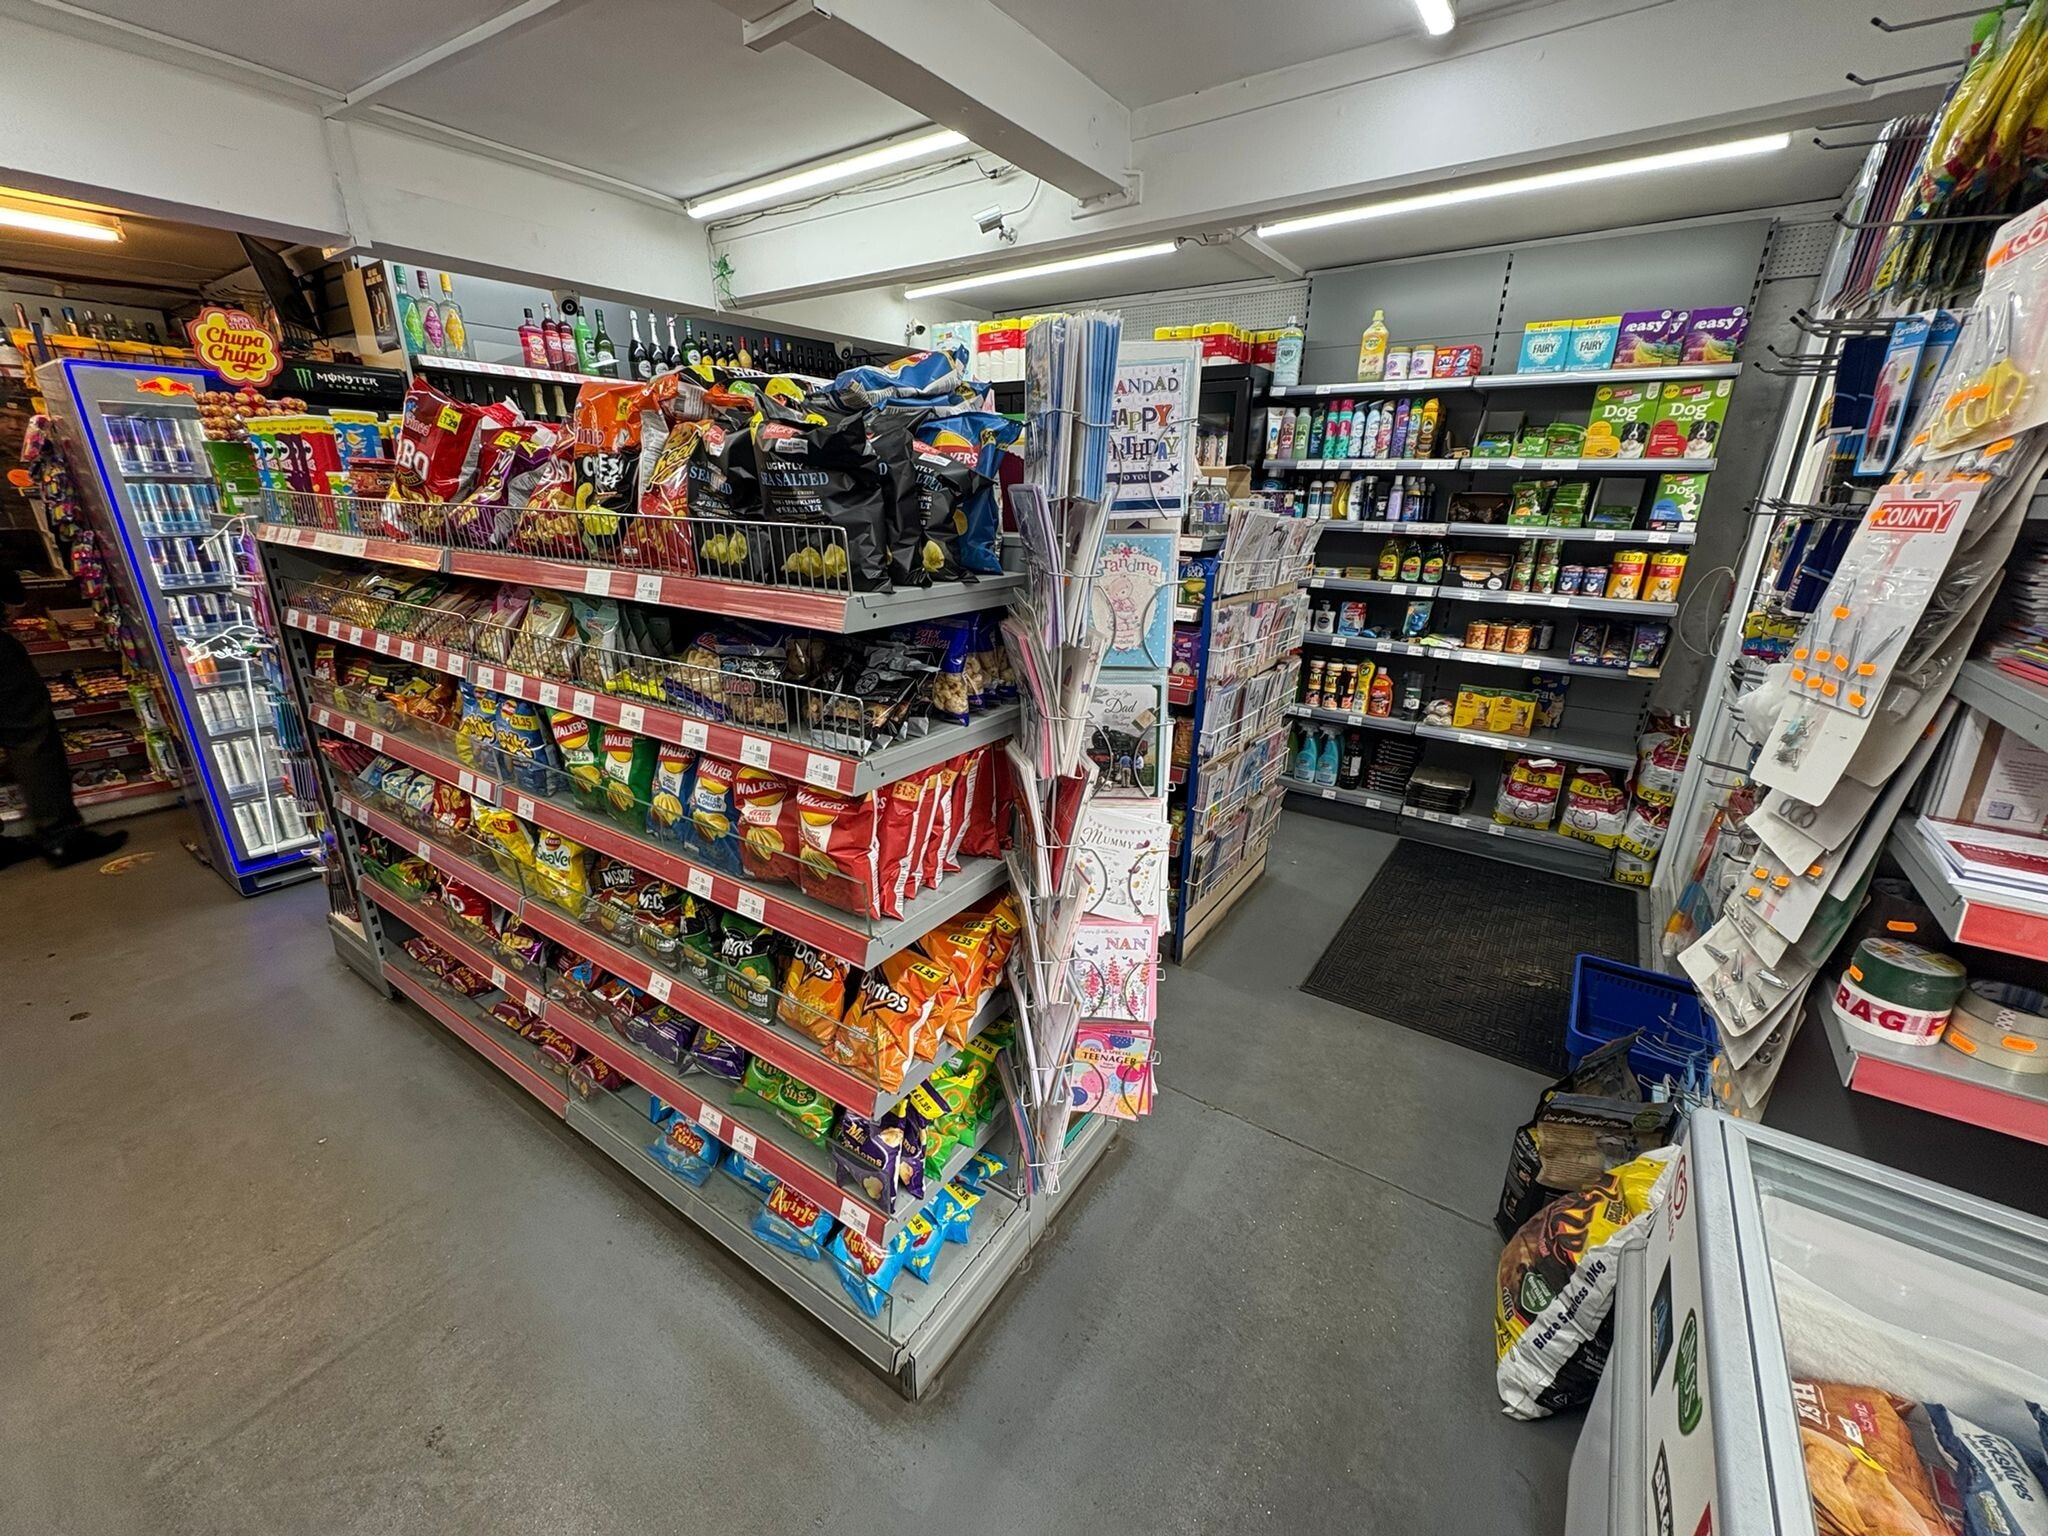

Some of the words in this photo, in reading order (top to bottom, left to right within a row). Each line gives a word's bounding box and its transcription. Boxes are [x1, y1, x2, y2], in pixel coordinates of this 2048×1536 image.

[1625, 319, 1667, 334] easy
[1694, 316, 1738, 331] easy
[206, 327, 265, 350] Chupa
[1580, 340, 1603, 351] FAIRY
[1533, 343, 1557, 354] FAIRY
[207, 344, 267, 372] Chups
[316, 371, 379, 387] MONSTER
[1115, 375, 1180, 395] ANDAD
[1602, 403, 1645, 422] Dog
[1669, 401, 1713, 421] Dog
[1111, 436, 1180, 461] RTHDAY
[399, 439, 429, 481] BQ
[766, 461, 804, 471] LIGHTLY
[776, 471, 830, 487] SALTED
[1665, 483, 1698, 499] Dog
[1877, 500, 1959, 533] COUNTY
[1103, 557, 1158, 577] randma
[1620, 555, 1643, 563] £1.79
[1659, 555, 1682, 564] £1.79
[1583, 655, 1598, 665] Cat
[1613, 658, 1628, 667] Cat
[1104, 698, 1138, 715] Dad
[553, 720, 588, 738] WALKERS
[700, 760, 733, 782] WALKER
[796, 791, 848, 811] WALKERS
[1642, 789, 1672, 804] £1.79
[1570, 830, 1596, 845] £1.79
[1617, 872, 1645, 884] £1.79
[950, 934, 974, 947] £1.35
[1105, 936, 1148, 950] NAN
[911, 963, 938, 979] £1.35
[727, 977, 748, 1000] WIN
[860, 971, 910, 1014] Doritos
[970, 1037, 995, 1055] £1.35
[1082, 1051, 1137, 1066] TEENAGER
[768, 1190, 819, 1225] Twirls
[1973, 1432, 2034, 1502] Yorkshires
